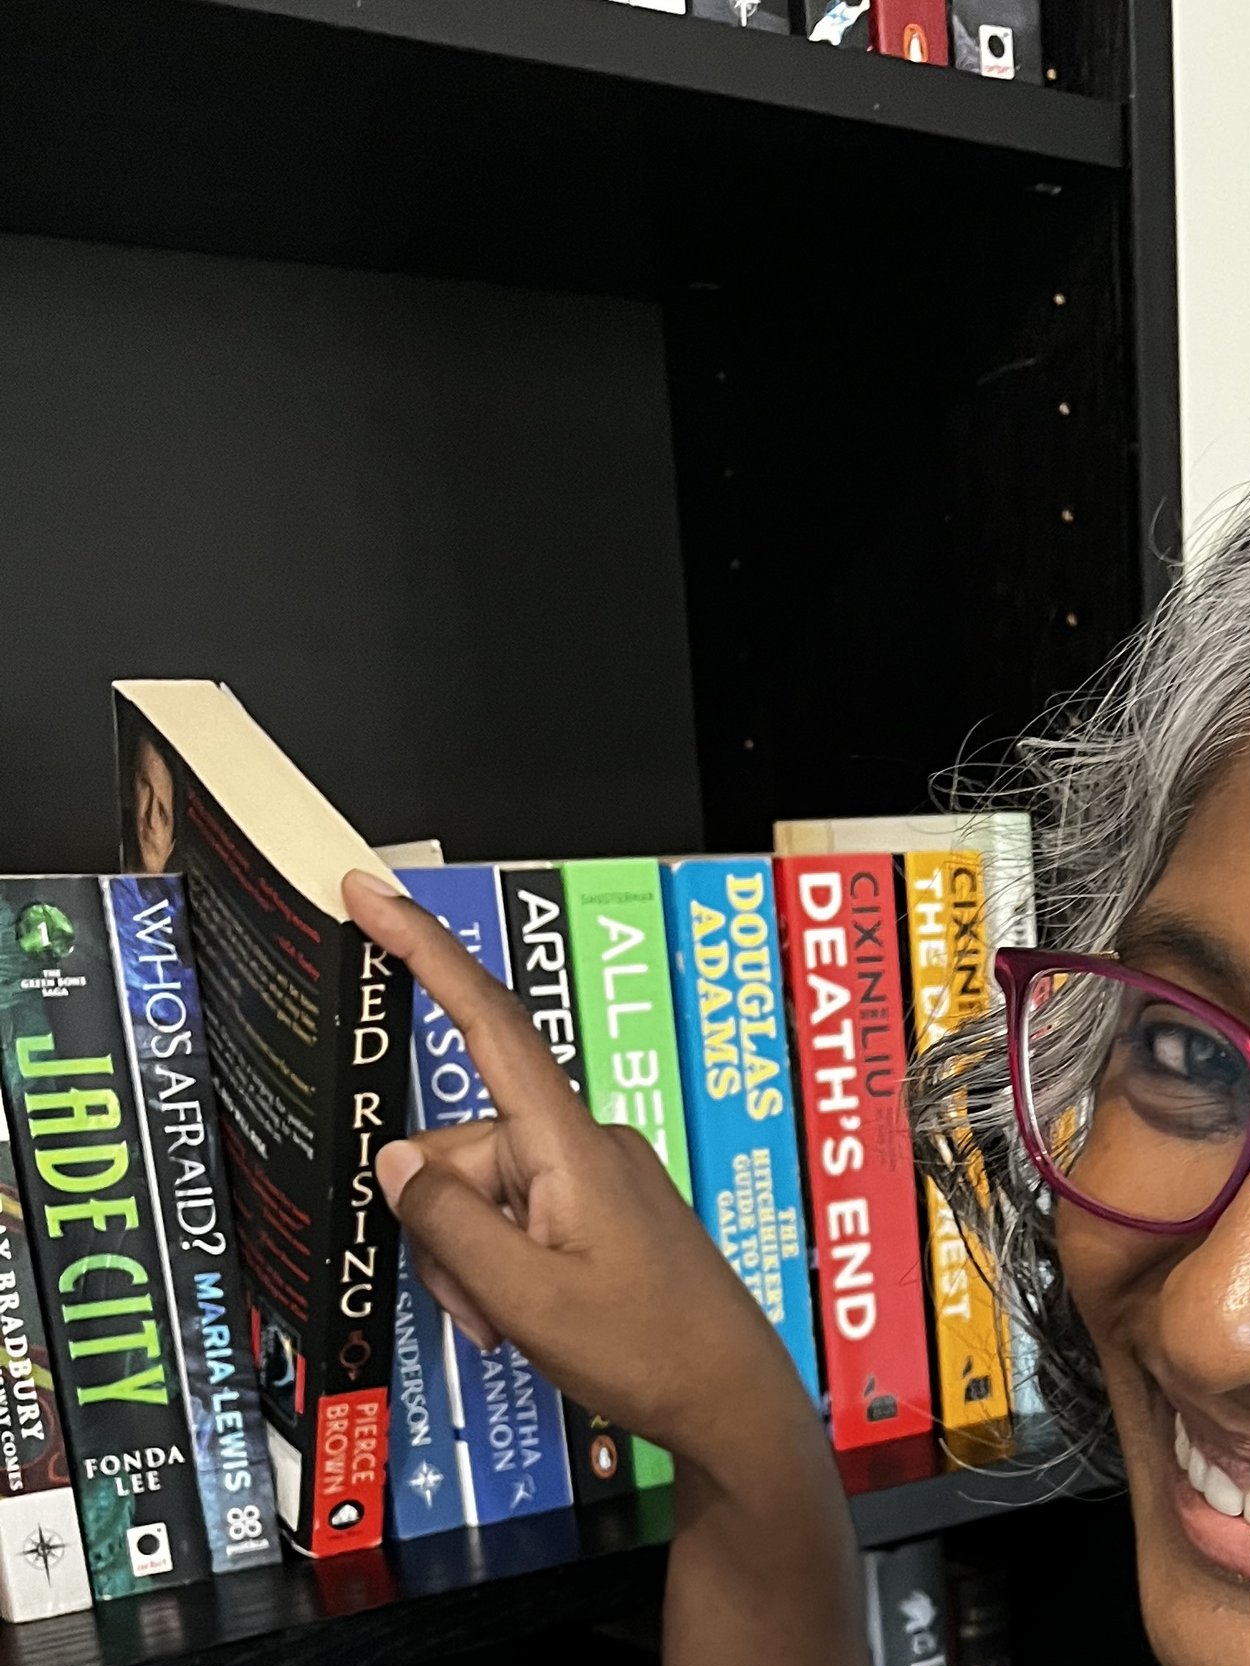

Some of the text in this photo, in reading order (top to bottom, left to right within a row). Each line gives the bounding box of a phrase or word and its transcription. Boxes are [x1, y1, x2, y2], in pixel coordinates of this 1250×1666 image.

[597, 915, 653, 1040] ALL
[851, 871, 887, 1004] CIXIN
[913, 868, 949, 970] THE
[951, 867, 981, 995] CIXIN
[690, 900, 741, 1100] ADAMS
[725, 872, 783, 1121] DOUGLAS
[798, 871, 878, 1341] DEATH'S END
[861, 1025, 895, 1098] LIU
[155, 1064, 227, 1256] AFRAID?
[340, 942, 392, 1319] RED RISING
[732, 1153, 756, 1231] GUIDE
[16, 1032, 170, 1407] JADE CITY
[740, 1234, 761, 1269] TO
[777, 1206, 800, 1259] THE
[0, 1270, 45, 1441] BRADBURY
[194, 1271, 250, 1493] MARIA LEWIS
[395, 1291, 432, 1447] SANDERSON
[84, 1445, 186, 1480] FONDA
[114, 1470, 163, 1497] LEE
[323, 1402, 351, 1496] BROWN
[352, 1402, 379, 1485] PIERCE
